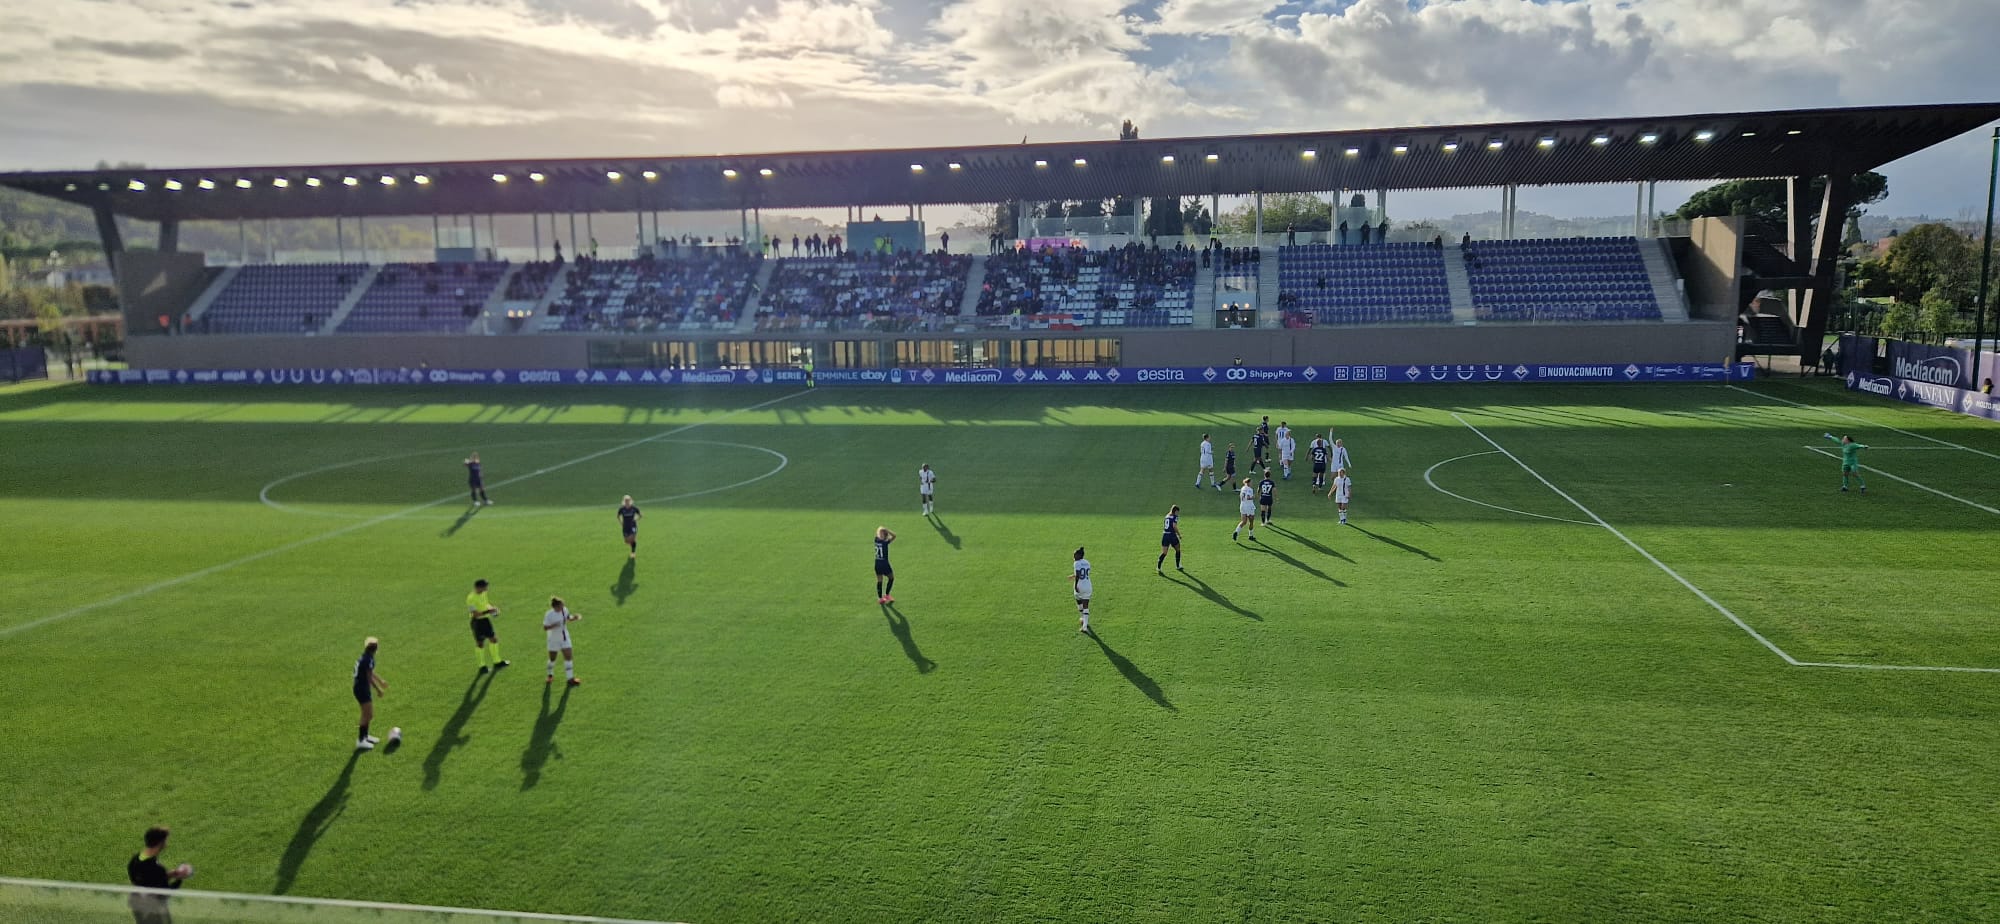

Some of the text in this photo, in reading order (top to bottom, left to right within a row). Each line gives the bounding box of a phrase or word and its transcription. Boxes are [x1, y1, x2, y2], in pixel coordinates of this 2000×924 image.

[682, 371, 731, 382] Mediacom
[776, 372, 801, 380] SERIE
[811, 372, 858, 380] FEMMINILE
[861, 371, 887, 382] ebay
[945, 371, 997, 382] Mediacom
[1148, 368, 1185, 380] estra
[1250, 369, 1293, 379] ShippyPro
[1547, 367, 1613, 377] NUOVACOMAUTO
[1896, 357, 1953, 385] Mediacom
[1858, 377, 1890, 395] Mediacom
[1913, 383, 1955, 405] FANFANI
[1314, 452, 1324, 461] 22
[1261, 484, 1273, 494] 87
